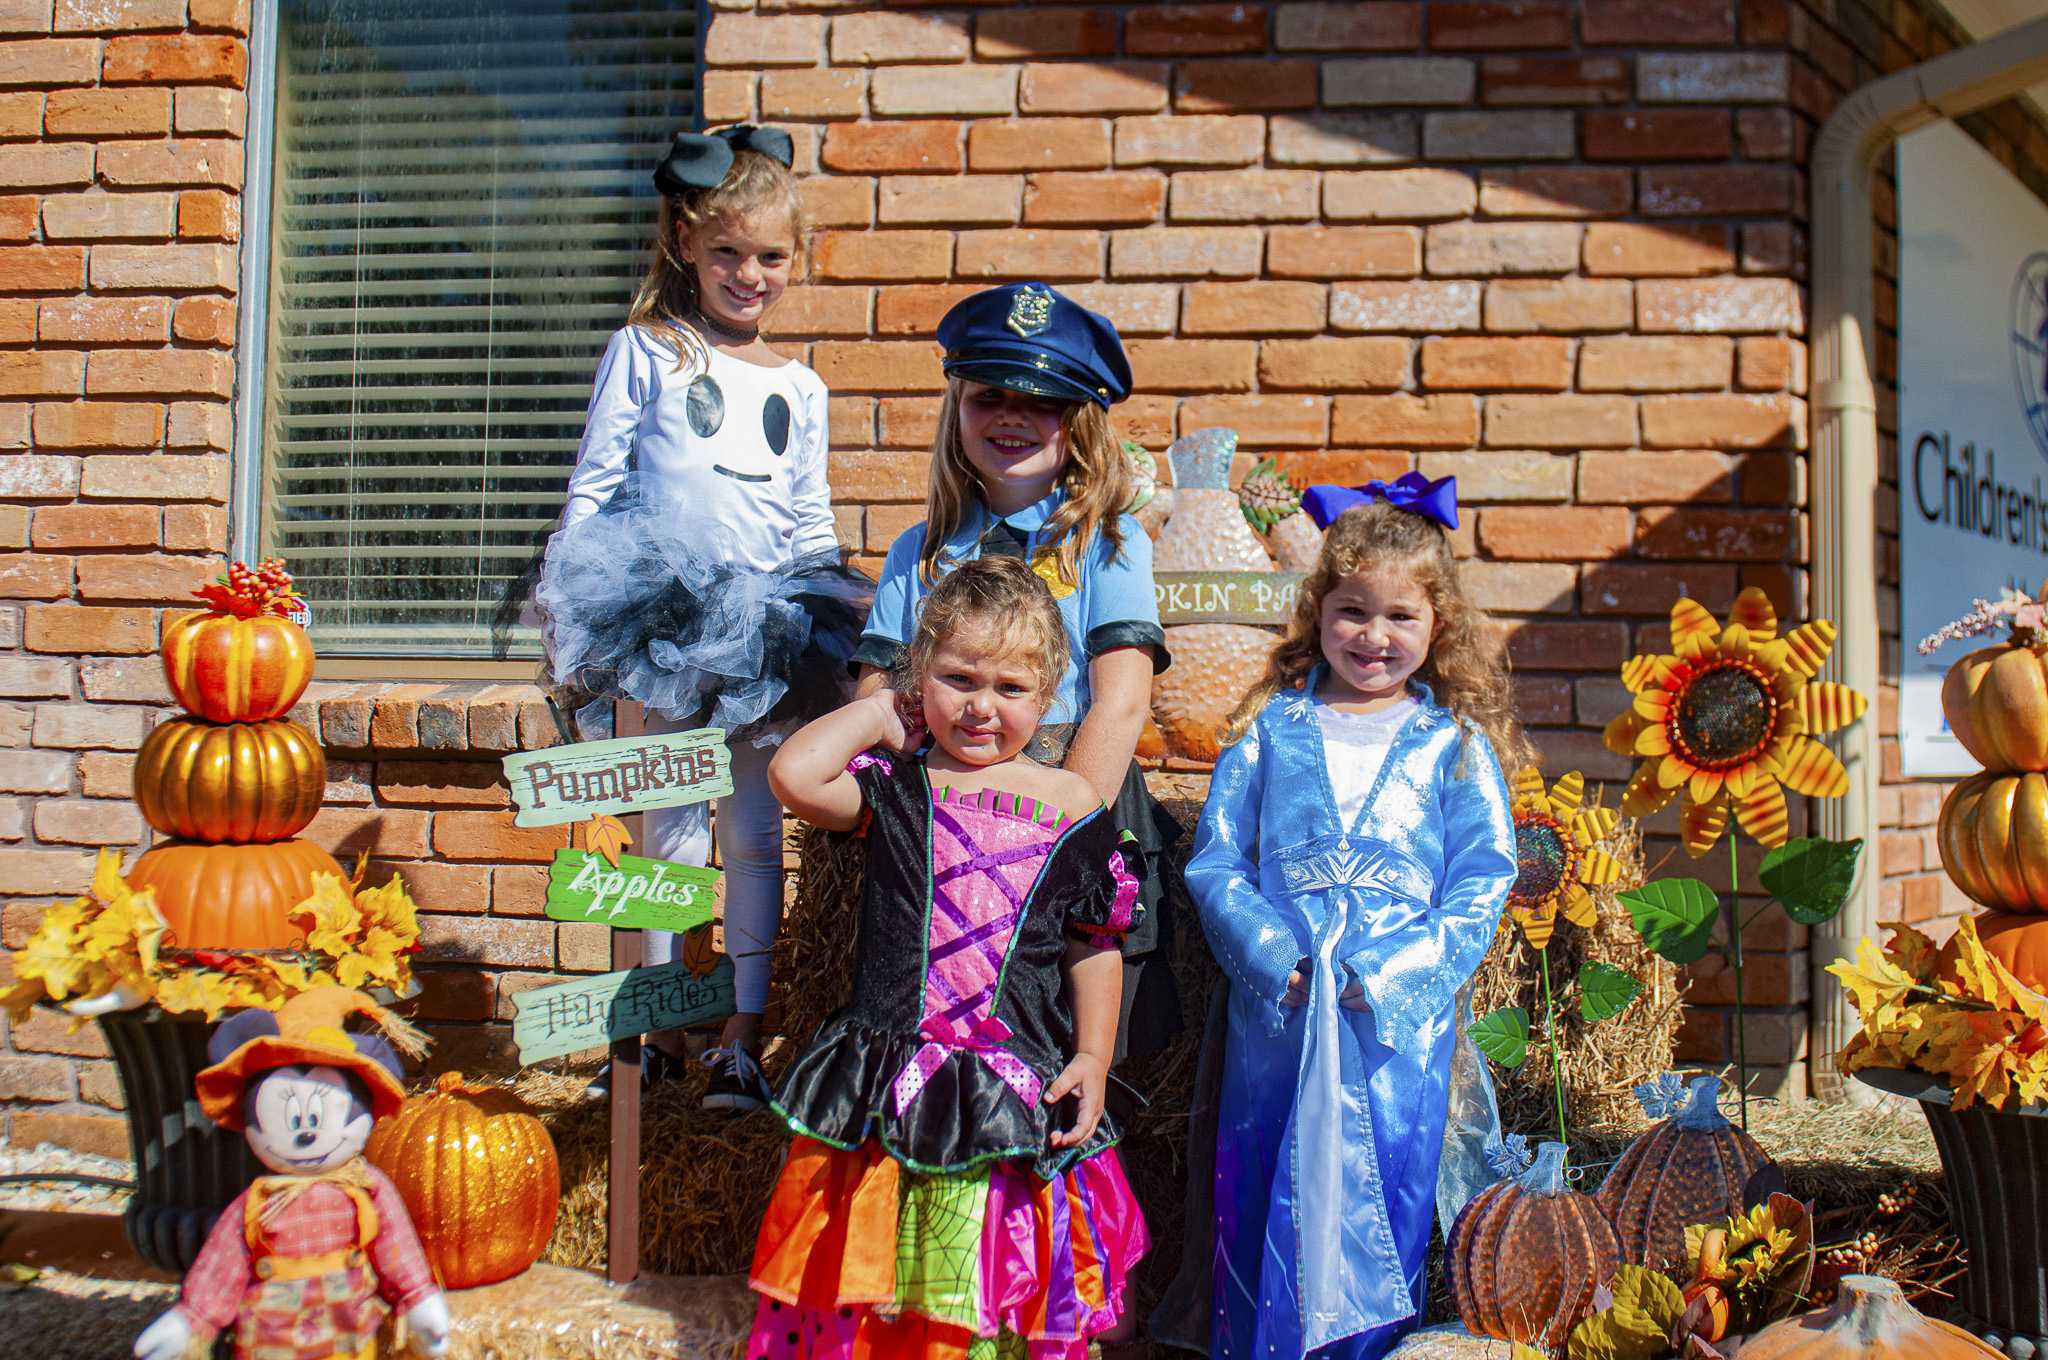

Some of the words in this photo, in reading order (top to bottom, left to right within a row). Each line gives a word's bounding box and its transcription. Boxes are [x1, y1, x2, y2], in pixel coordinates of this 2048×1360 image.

[524, 744, 717, 809] Pumpkins
[568, 854, 698, 918] Apples
[544, 991, 616, 1040] Hay
[630, 971, 718, 1026] Rides
